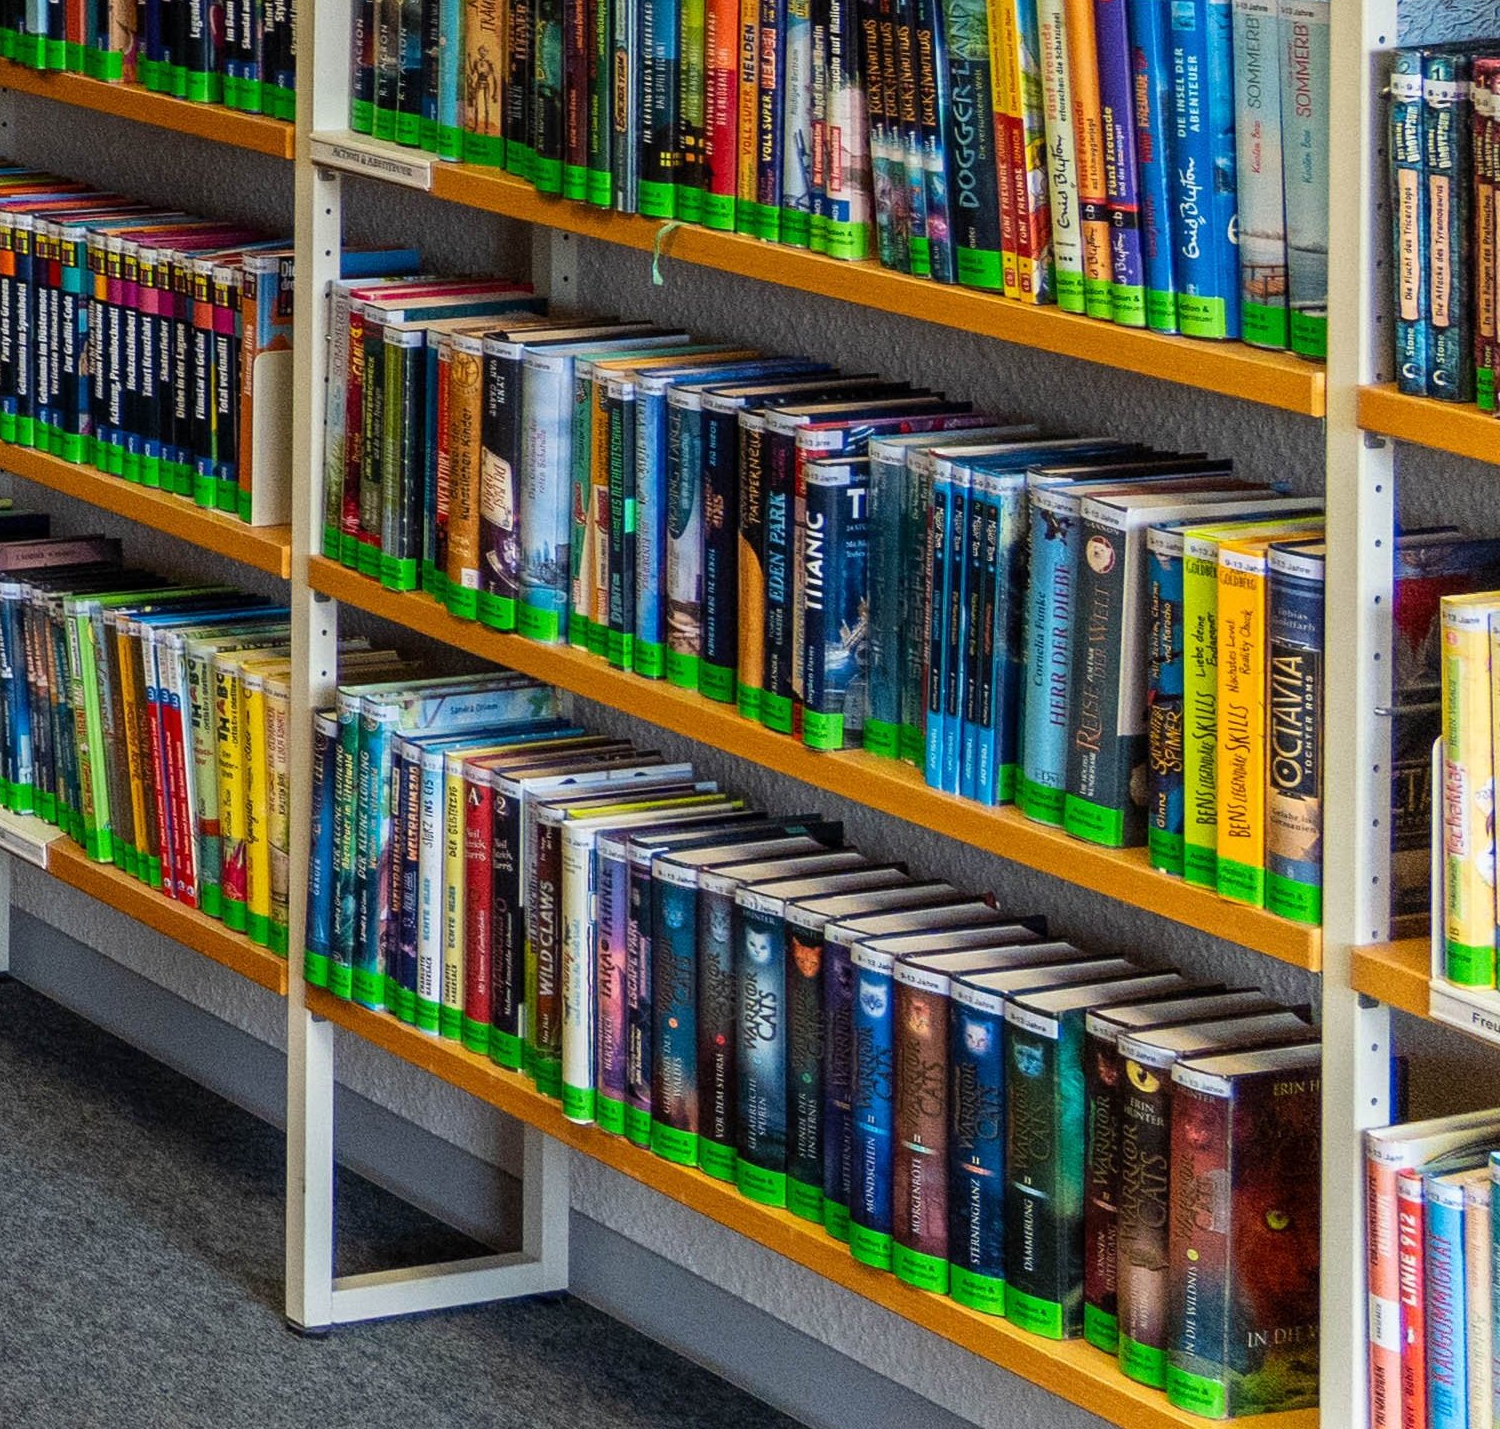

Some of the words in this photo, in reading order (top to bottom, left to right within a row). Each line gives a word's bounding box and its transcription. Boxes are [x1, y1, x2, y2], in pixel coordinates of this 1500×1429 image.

[1175, 48, 1184, 73] DER
[1175, 78, 1185, 112] INSEL
[1189, 55, 1199, 132] ABENTEUER
[1176, 118, 1185, 138] DIE
[333, 148, 359, 162] ACTION
[1405, 186, 1414, 233] Triceratops
[1404, 256, 1413, 283] Flucht
[1404, 287, 1413, 301] Die
[1405, 327, 1415, 357] Stone
[438, 451, 451, 516] INVENTORY
[770, 490, 787, 545] PARK
[768, 552, 786, 605] EDEN
[803, 512, 824, 610] TITANIC
[1305, 674, 1314, 713] ROMS
[1273, 655, 1303, 789] OCTAVIA
[1304, 718, 1313, 775] TOCHTER
[542, 881, 554, 945] CLAWS
[539, 949, 552, 996] WILD
[757, 990, 777, 1041] CATS
[866, 1137, 876, 1214] MONDSCHEIN
